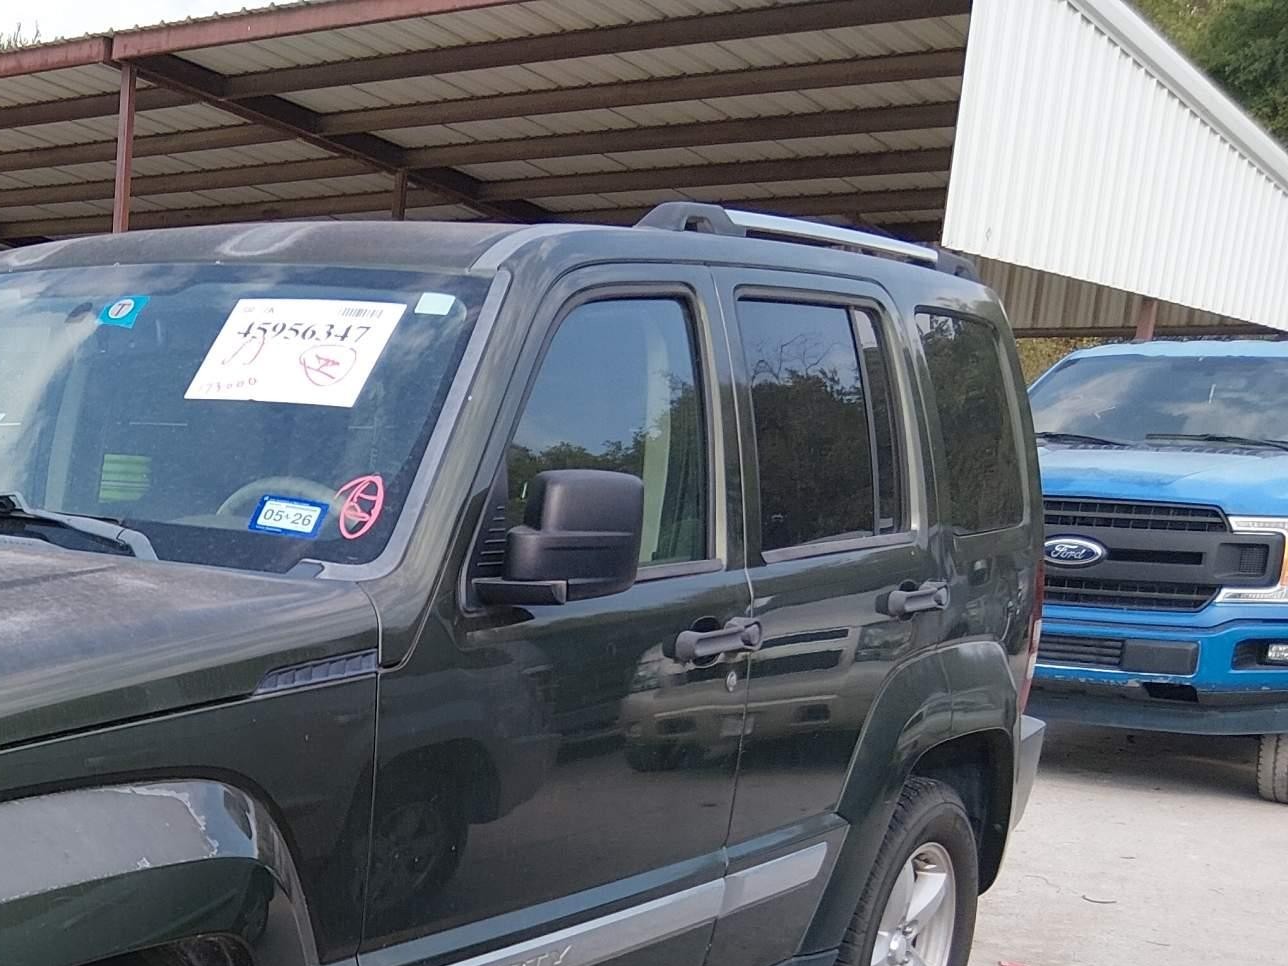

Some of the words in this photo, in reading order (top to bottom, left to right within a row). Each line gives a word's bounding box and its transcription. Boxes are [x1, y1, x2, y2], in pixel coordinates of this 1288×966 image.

[237, 320, 372, 343] 45956347
[263, 508, 286, 522] 05
[290, 512, 313, 527] 26
[1050, 543, 1087, 560] Ford
